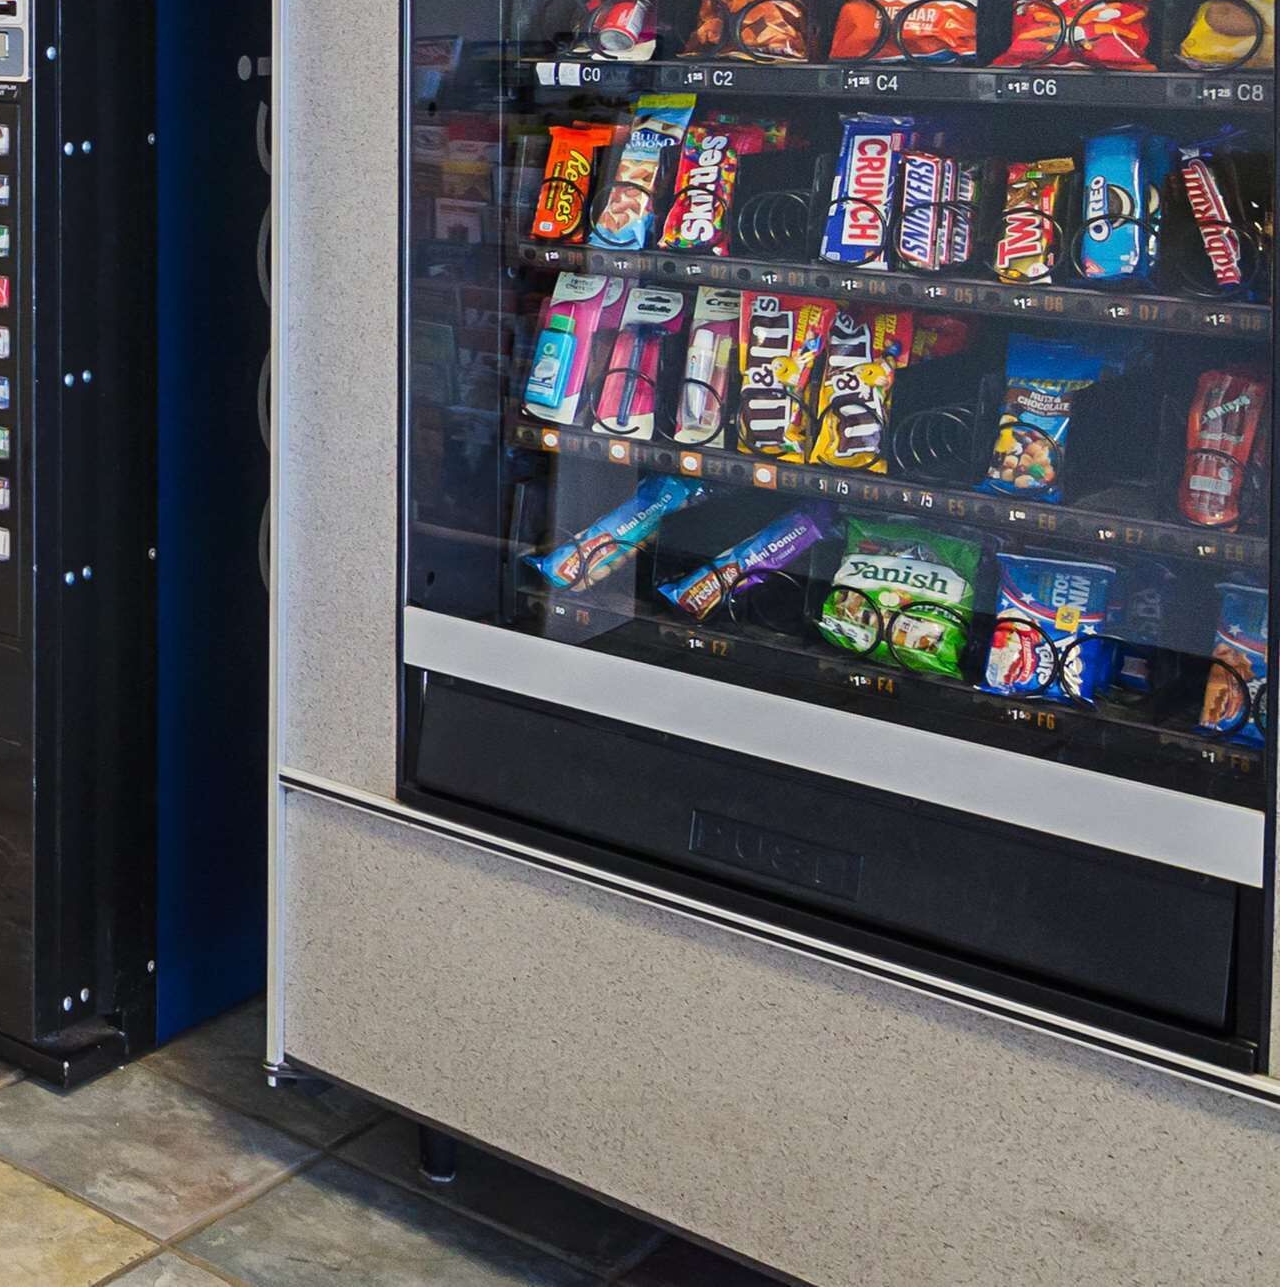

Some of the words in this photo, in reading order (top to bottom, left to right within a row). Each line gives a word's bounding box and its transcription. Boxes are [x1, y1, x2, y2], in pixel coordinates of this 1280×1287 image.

[582, 68, 601, 82] C0
[713, 71, 734, 86] C2
[876, 74, 899, 92] C4
[1032, 79, 1057, 96] C6
[1238, 84, 1264, 102] C8
[848, 138, 890, 241] CRUNCH
[1087, 175, 1110, 242] OREO
[705, 298, 741, 308] Cres
[1017, 396, 1071, 412] CHOCOLATE
[616, 518, 639, 537] Mini
[638, 493, 673, 519] Donuts
[744, 549, 770, 568] Mini
[768, 525, 808, 553] Donuts
[877, 676, 895, 694] F4
[1037, 712, 1056, 730] F6
